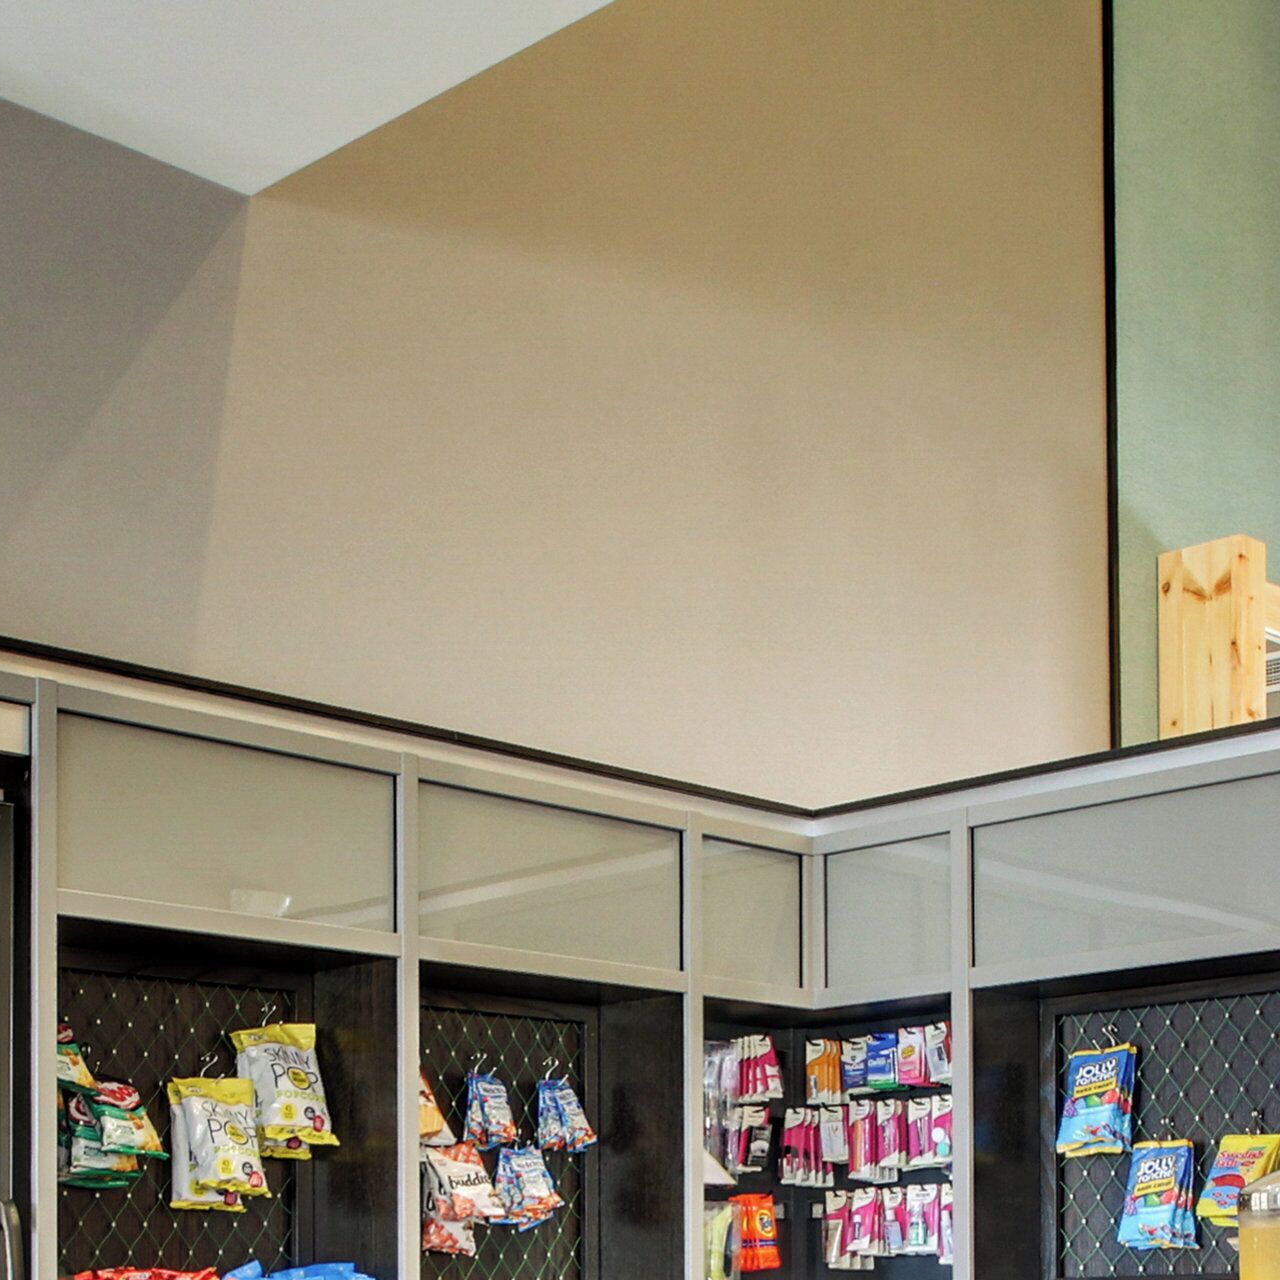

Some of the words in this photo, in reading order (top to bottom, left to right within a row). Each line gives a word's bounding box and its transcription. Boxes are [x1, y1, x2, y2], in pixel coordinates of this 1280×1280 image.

[270, 1062, 318, 1093] POP
[1075, 1058, 1118, 1080] JOLLY
[206, 1119, 257, 1148] POP
[1137, 1156, 1176, 1177] JOLLY
[1219, 1150, 1265, 1161] Swedish
